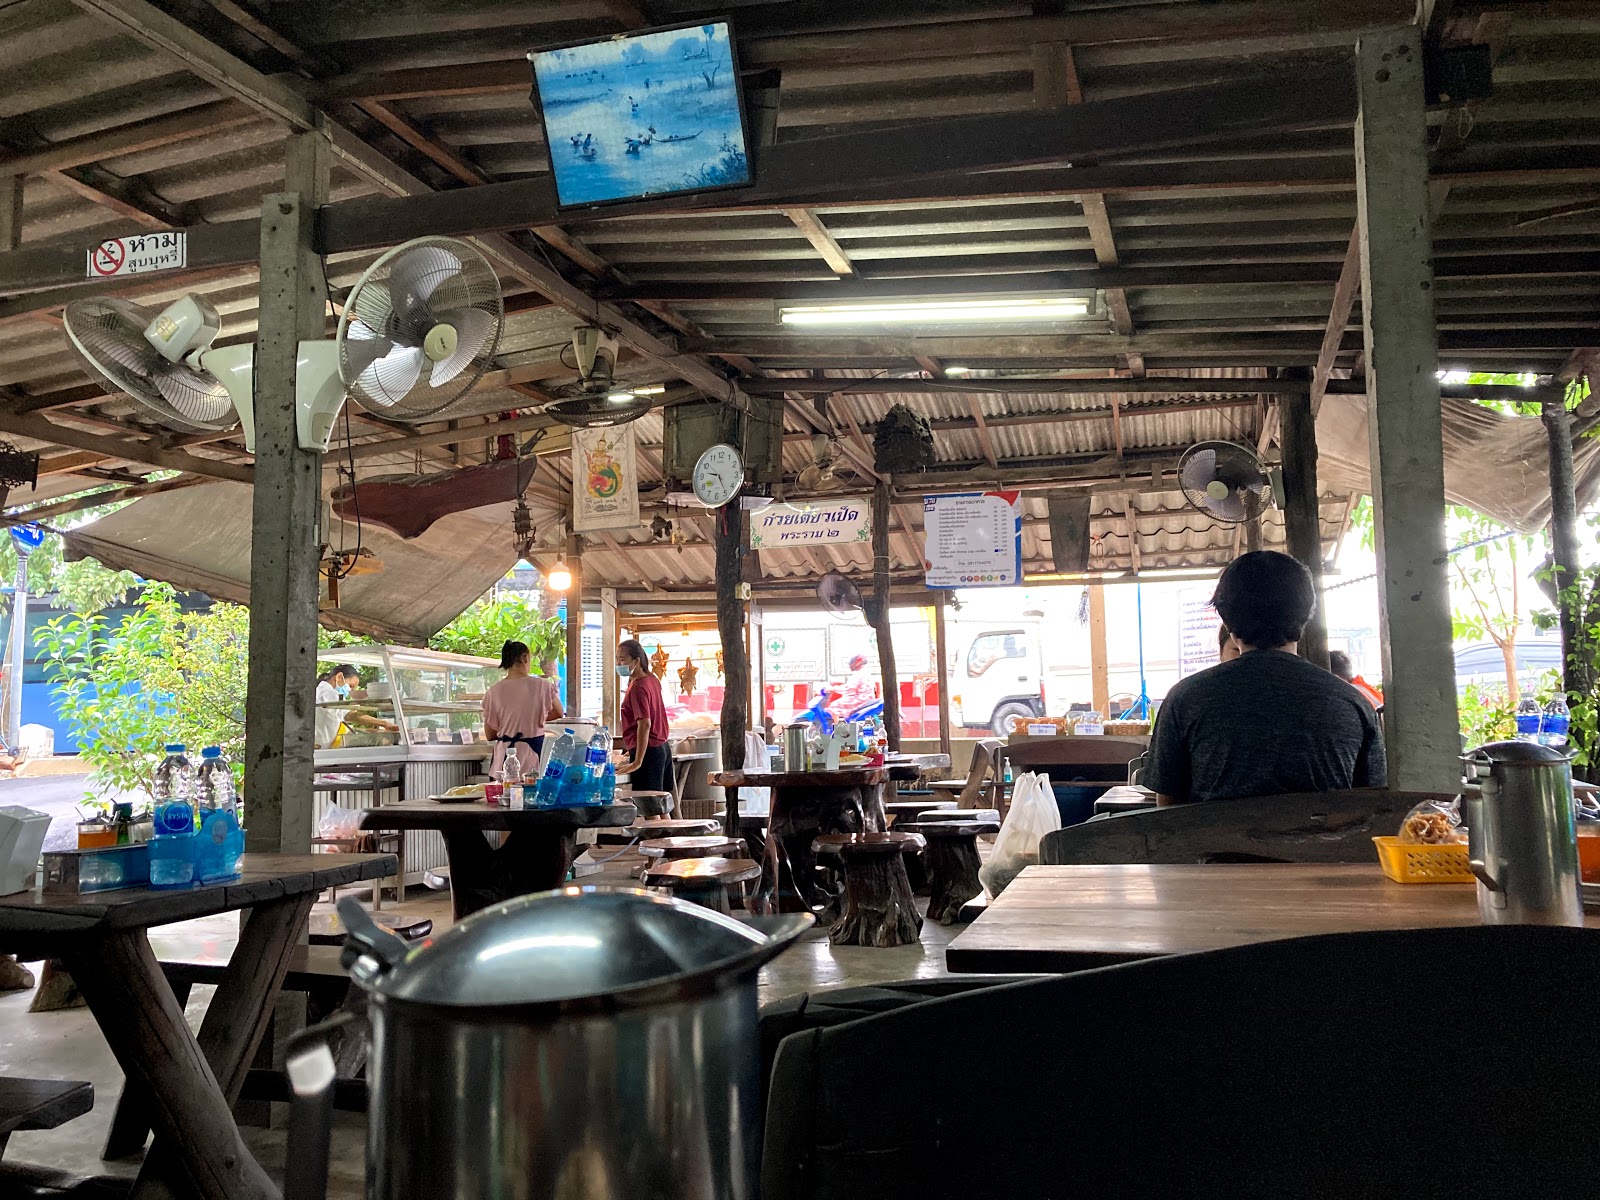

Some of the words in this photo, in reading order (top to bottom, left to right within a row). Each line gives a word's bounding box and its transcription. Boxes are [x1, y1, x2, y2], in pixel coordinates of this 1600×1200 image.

[128, 232, 178, 253] หาม
[128, 246, 178, 273] สูบบุหรี่
[718, 451, 725, 459] 12
[703, 462, 710, 470] 10
[732, 460, 737, 468] 2
[714, 492, 719, 500] 6
[723, 489, 728, 497] 5
[827, 528, 840, 538] ๒
